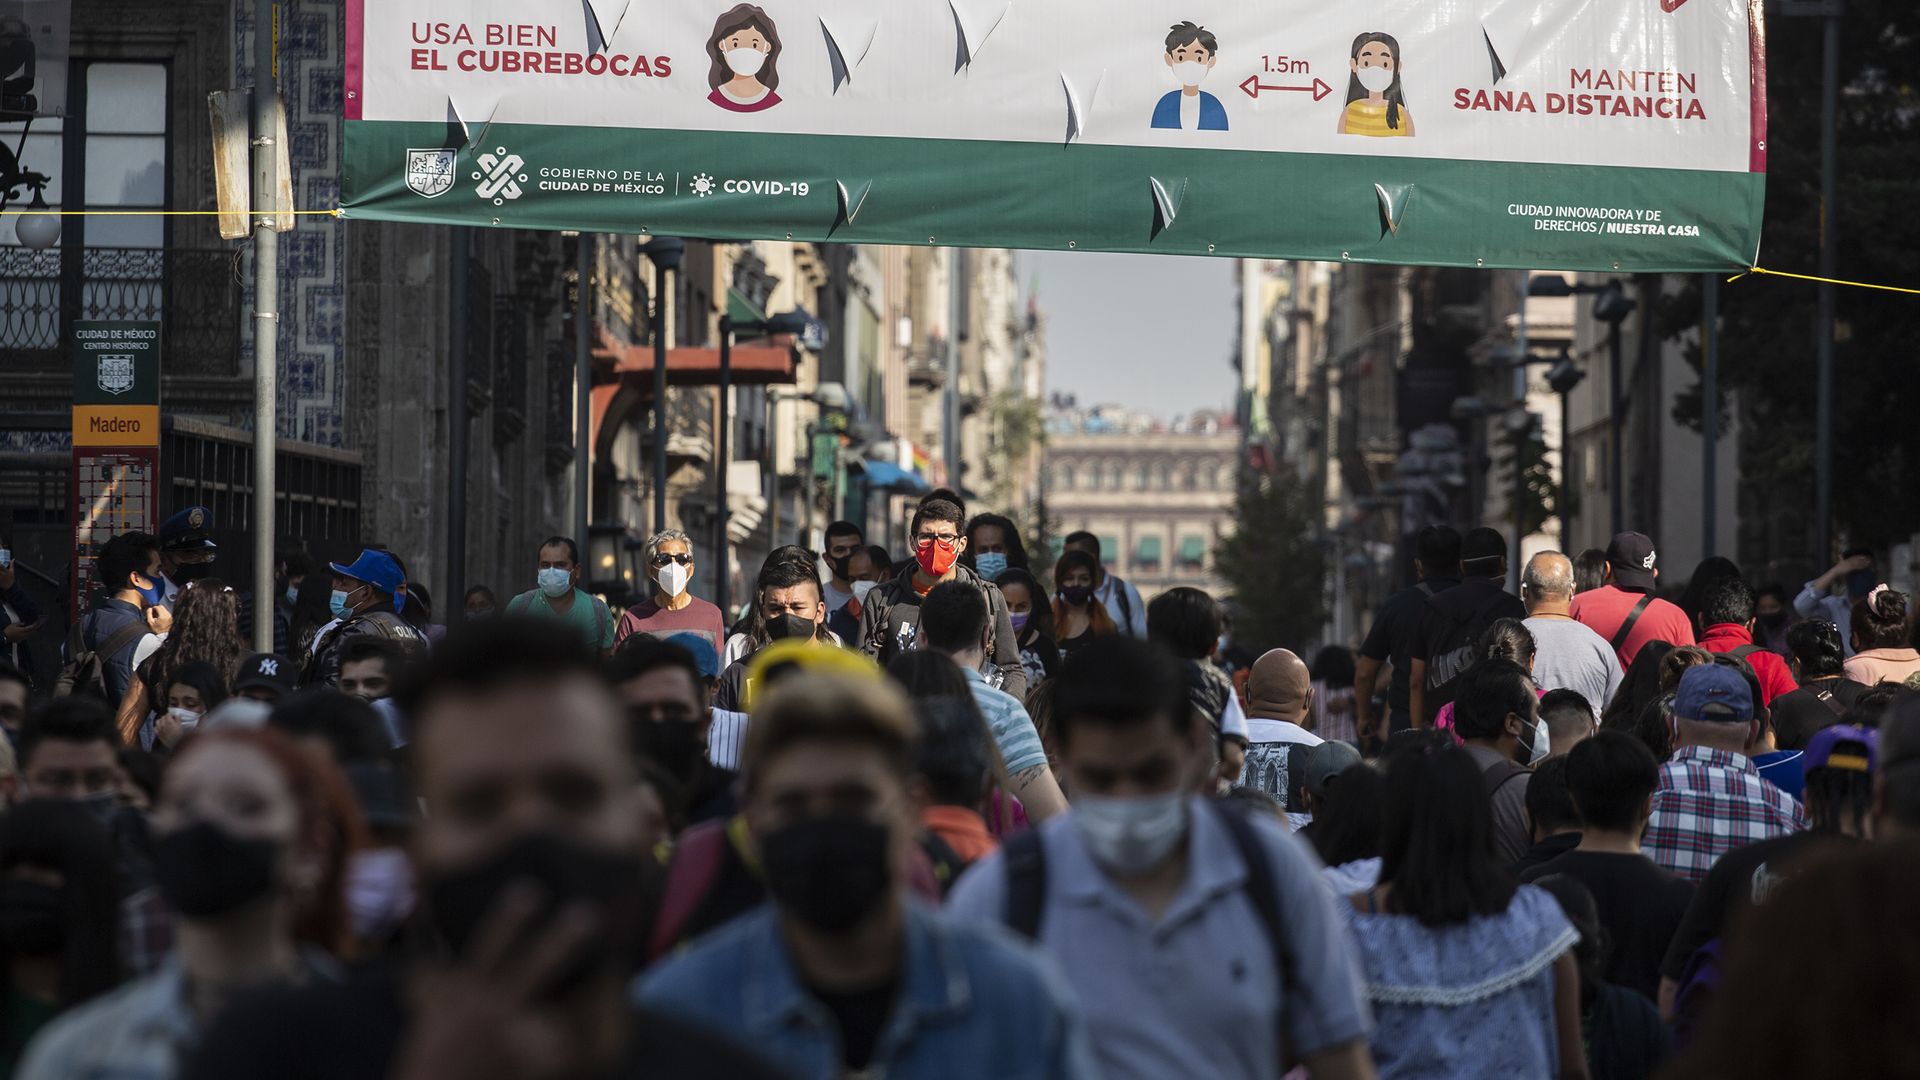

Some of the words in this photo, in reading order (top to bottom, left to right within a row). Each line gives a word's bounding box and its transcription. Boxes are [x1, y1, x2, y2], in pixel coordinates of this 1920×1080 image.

[411, 22, 474, 45] USA
[485, 24, 557, 47] BIEN
[411, 48, 448, 70] EL
[457, 50, 672, 78] CUBREBOCAS
[1261, 55, 1309, 74] 1.5m
[1453, 88, 1537, 113] SANA
[1545, 93, 1707, 120] DISTANCIA
[539, 167, 618, 181] GOBIERNO
[623, 170, 642, 181] DE
[647, 171, 665, 182] LA
[538, 181, 590, 192] CIUDAD
[593, 182, 610, 192] DE
[614, 180, 664, 194] MÉXICO
[723, 179, 809, 197] COVID-19
[1507, 204, 1553, 217] CIUDAD
[1555, 206, 1634, 220] INNOVADORA
[1635, 209, 1644, 221] Y
[1645, 210, 1661, 222] DE
[1534, 219, 1597, 233] DERECHOS
[1598, 222, 1605, 235] /
[1606, 223, 1666, 236] NUESTRA
[1667, 225, 1700, 237] CASA
[76, 330, 109, 339] CIUDAD
[110, 330, 122, 339] DE
[123, 328, 156, 339] MÉXICO
[83, 342, 111, 350] CENTRO
[112, 341, 149, 350] HISTÓRICO
[90, 416, 141, 433] Madero
[258, 658, 279, 676] NY
